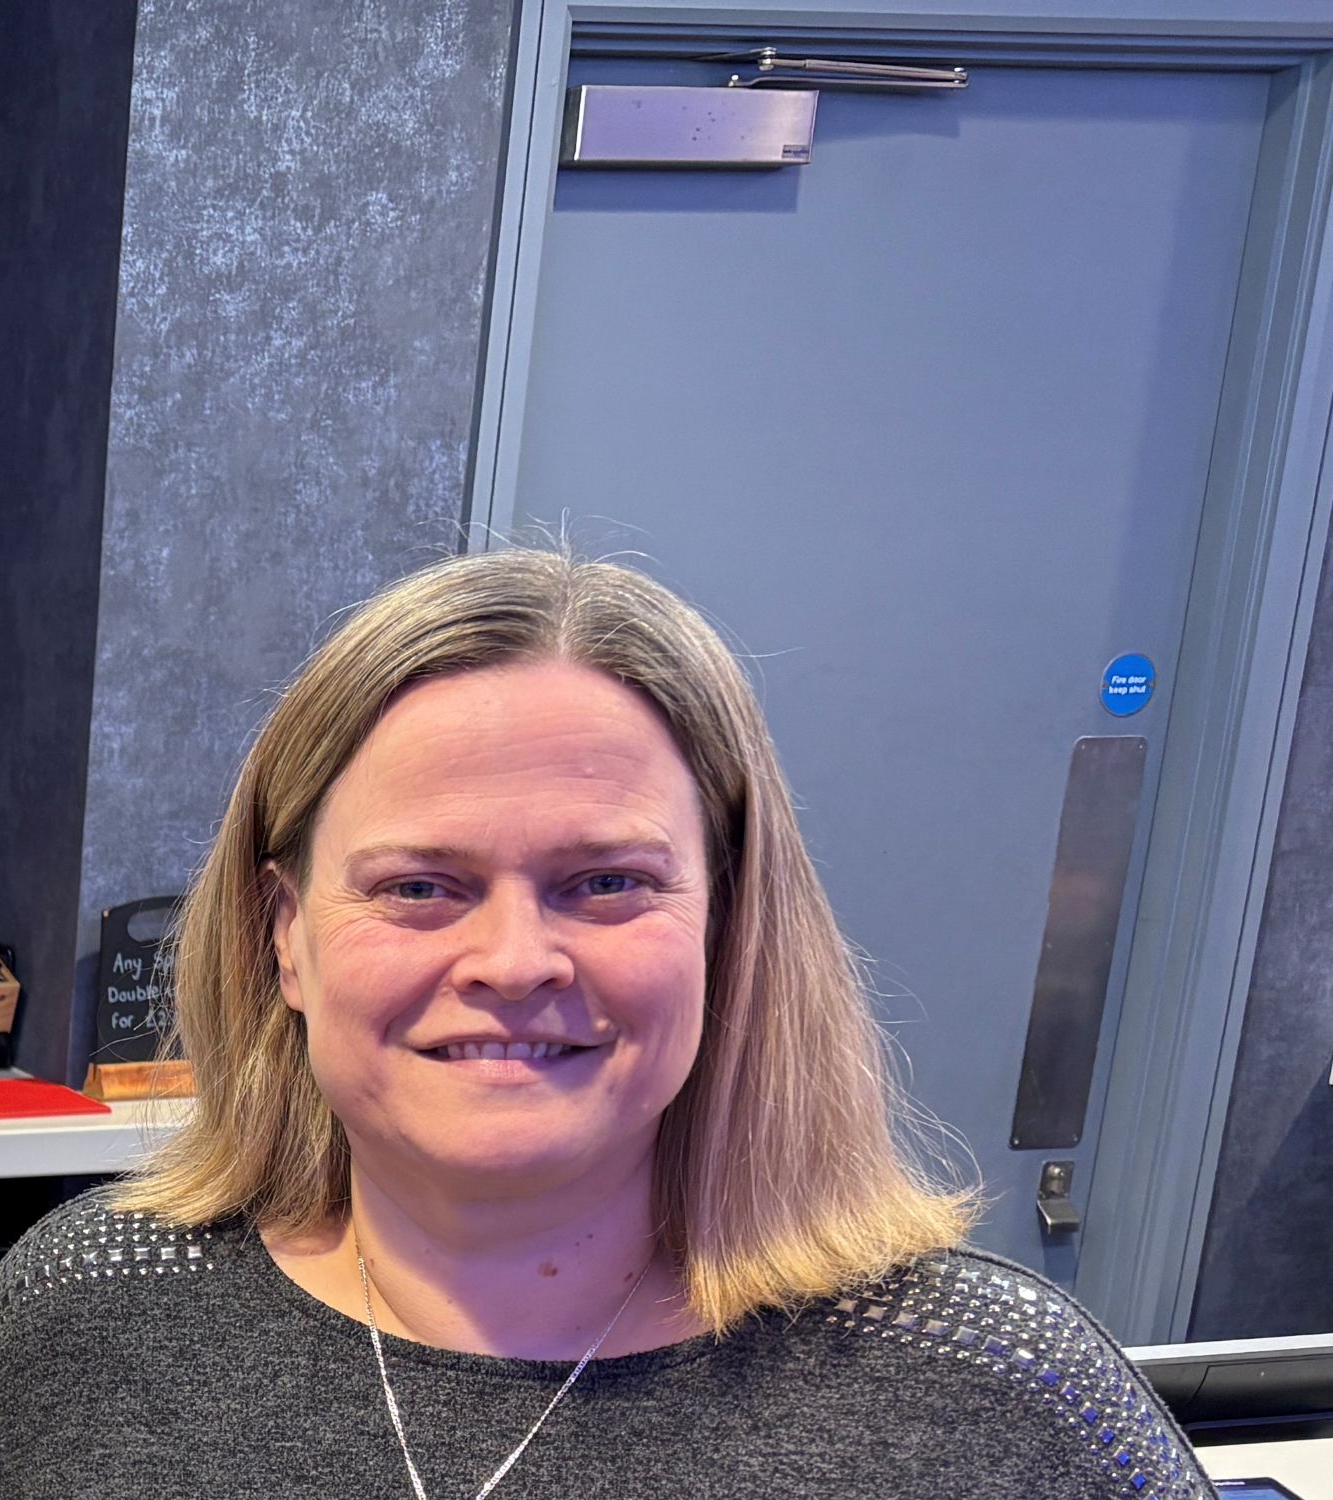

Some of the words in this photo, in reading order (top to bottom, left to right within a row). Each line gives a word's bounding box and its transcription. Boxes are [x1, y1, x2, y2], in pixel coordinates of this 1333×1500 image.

[1111, 675, 1126, 684] Fire
[1128, 675, 1147, 684] door
[1108, 685, 1128, 695] keep
[1129, 685, 1146, 694] shut
[113, 952, 142, 981] Any
